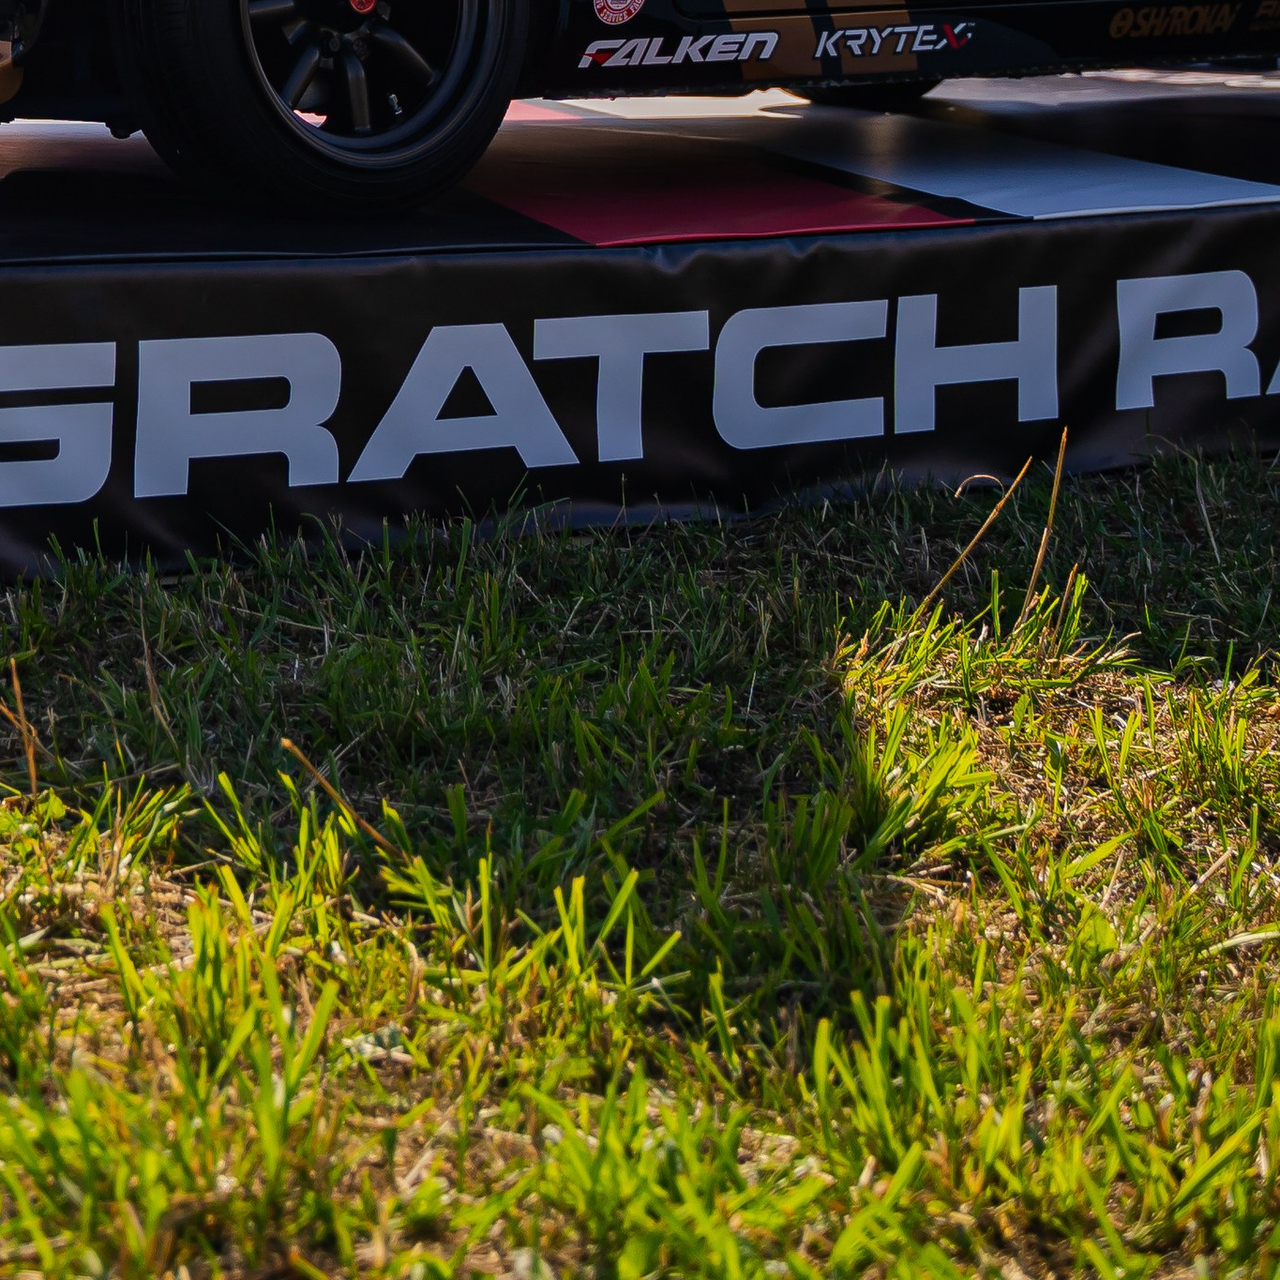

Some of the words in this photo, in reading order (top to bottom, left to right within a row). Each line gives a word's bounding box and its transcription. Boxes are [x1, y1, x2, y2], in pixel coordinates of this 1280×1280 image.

[600, 9, 629, 23] SERVICE
[578, 32, 779, 69] FALKEN
[1115, 269, 1280, 411] R
